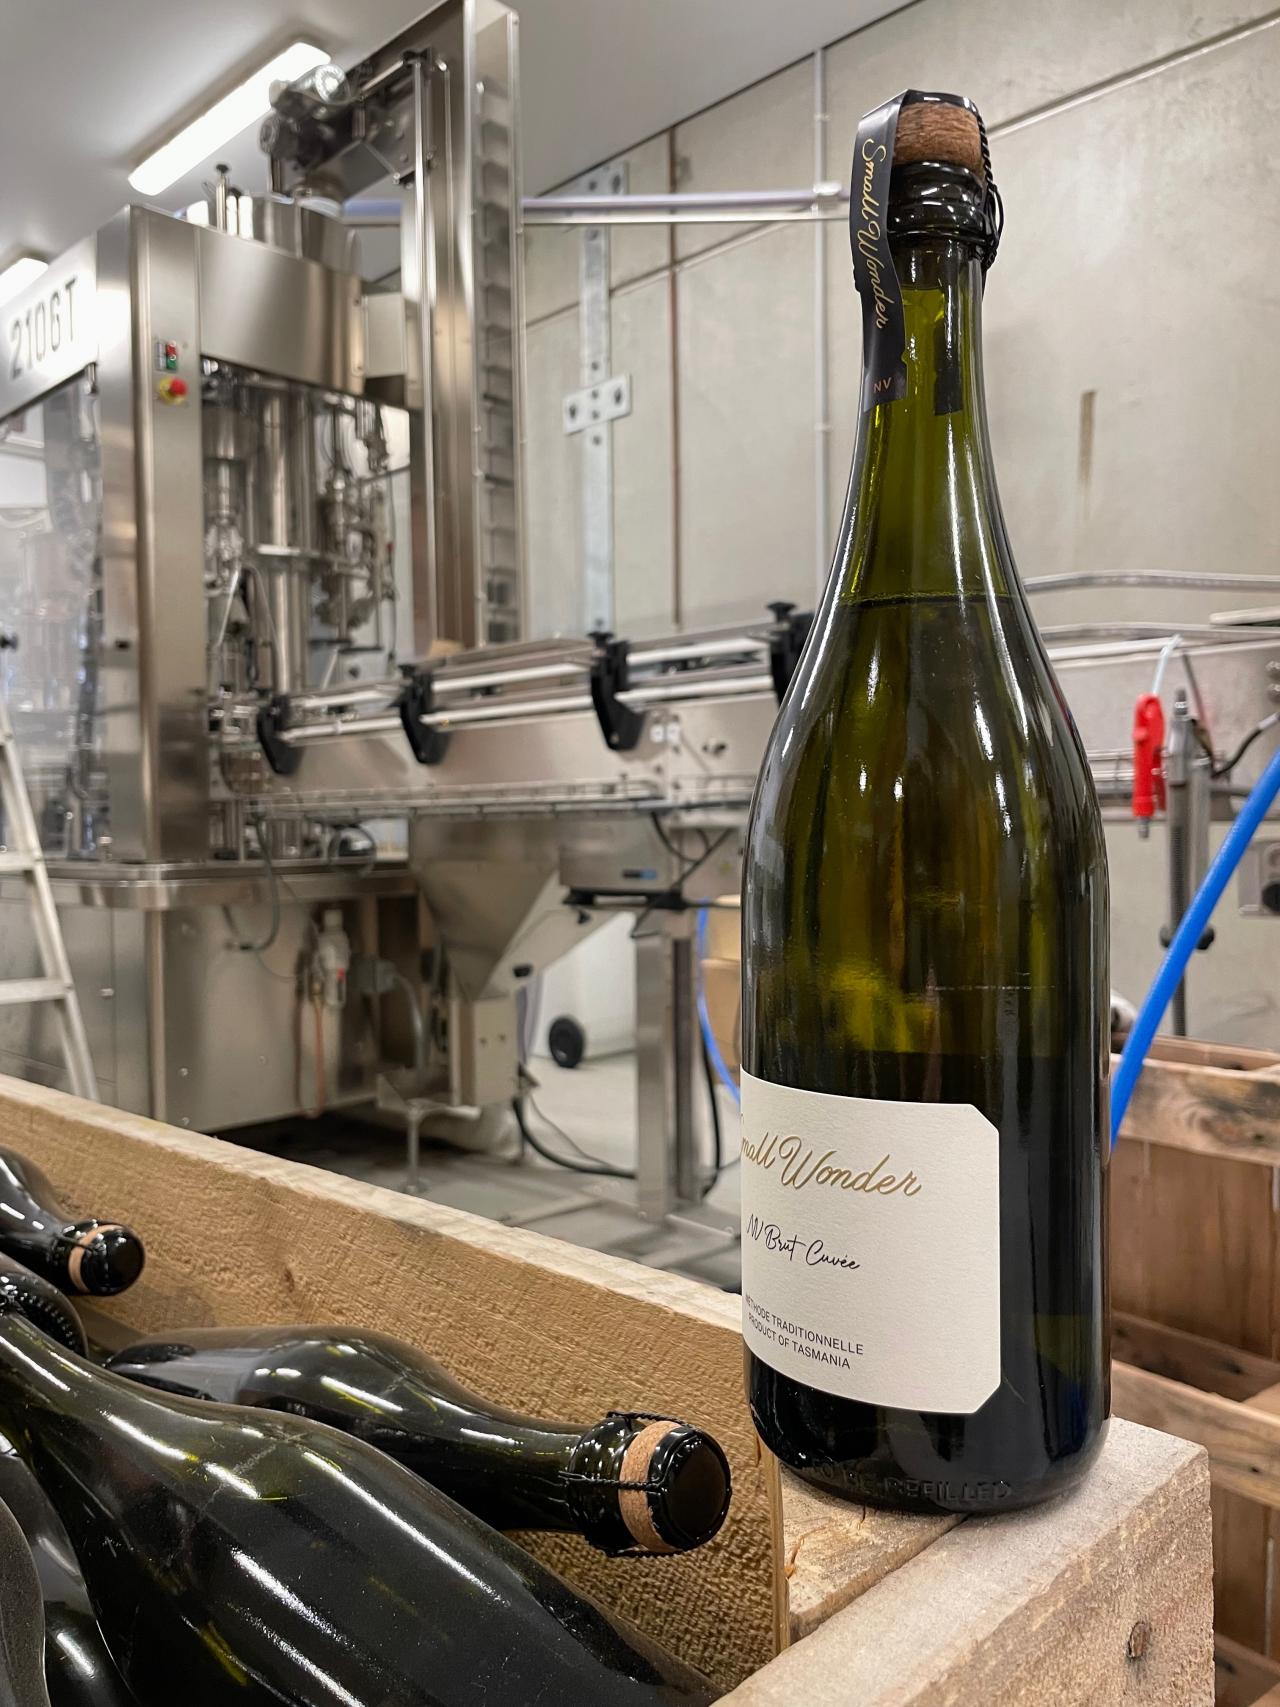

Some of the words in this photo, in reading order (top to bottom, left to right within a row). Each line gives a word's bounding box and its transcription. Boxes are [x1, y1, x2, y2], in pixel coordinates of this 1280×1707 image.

[861, 138, 887, 221] Small
[857, 220, 895, 329] Wonder
[9, 273, 78, 380] 2106T
[873, 376, 892, 393] NV
[779, 1135, 922, 1197] Wonder
[764, 1223, 807, 1261] Brut
[748, 1312, 777, 1341] PRODUCT
[778, 1334, 790, 1348] OF
[791, 1340, 851, 1370] TASMANIA
[771, 1314, 864, 1355] TRADITIONNELLE
